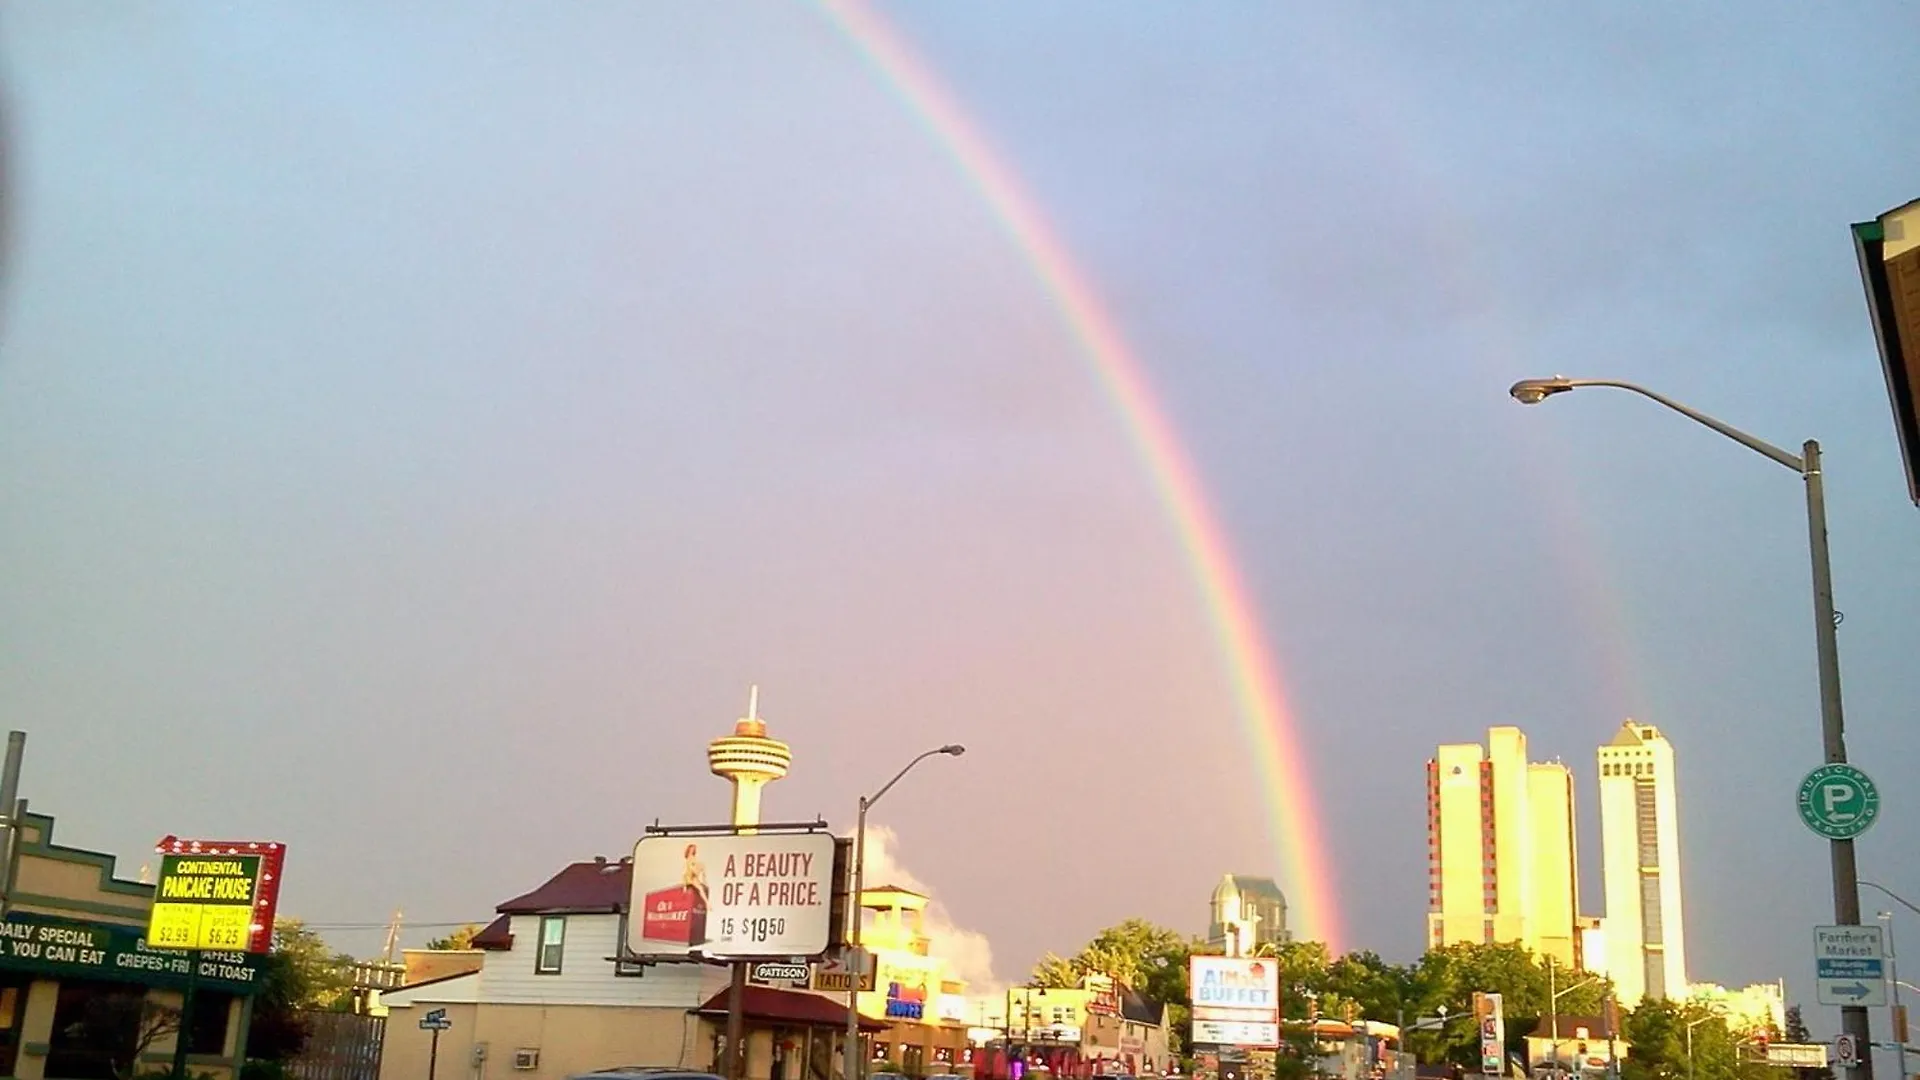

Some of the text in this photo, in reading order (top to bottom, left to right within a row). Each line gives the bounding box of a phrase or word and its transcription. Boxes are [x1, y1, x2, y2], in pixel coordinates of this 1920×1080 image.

[1801, 766, 1875, 800] MUNICIPAL
[1823, 784, 1854, 812] P
[1804, 810, 1875, 834] PARKING
[177, 861, 244, 875] CONTINENTAL
[724, 853, 814, 877] A BEAUTY
[162, 876, 252, 900] PANCAKE HOUSE
[722, 882, 822, 906] OF A PRICE.
[160, 926, 189, 942] $2.99
[722, 918, 734, 935] 15
[39, 927, 94, 947] SPECIAL
[209, 929, 239, 945] $6.25
[1819, 932, 1877, 943] Farmer's
[12, 941, 41, 958] YOU
[45, 945, 76, 962] CAN
[79, 949, 106, 965] EAT
[200, 949, 246, 965] AFFLES
[1826, 945, 1872, 956] Market
[116, 953, 164, 971] CREPES
[219, 964, 256, 981] TOAST
[759, 967, 806, 978] PATTISON
[820, 974, 867, 988] TATTOS
[1199, 986, 1270, 1003] BUFFET
